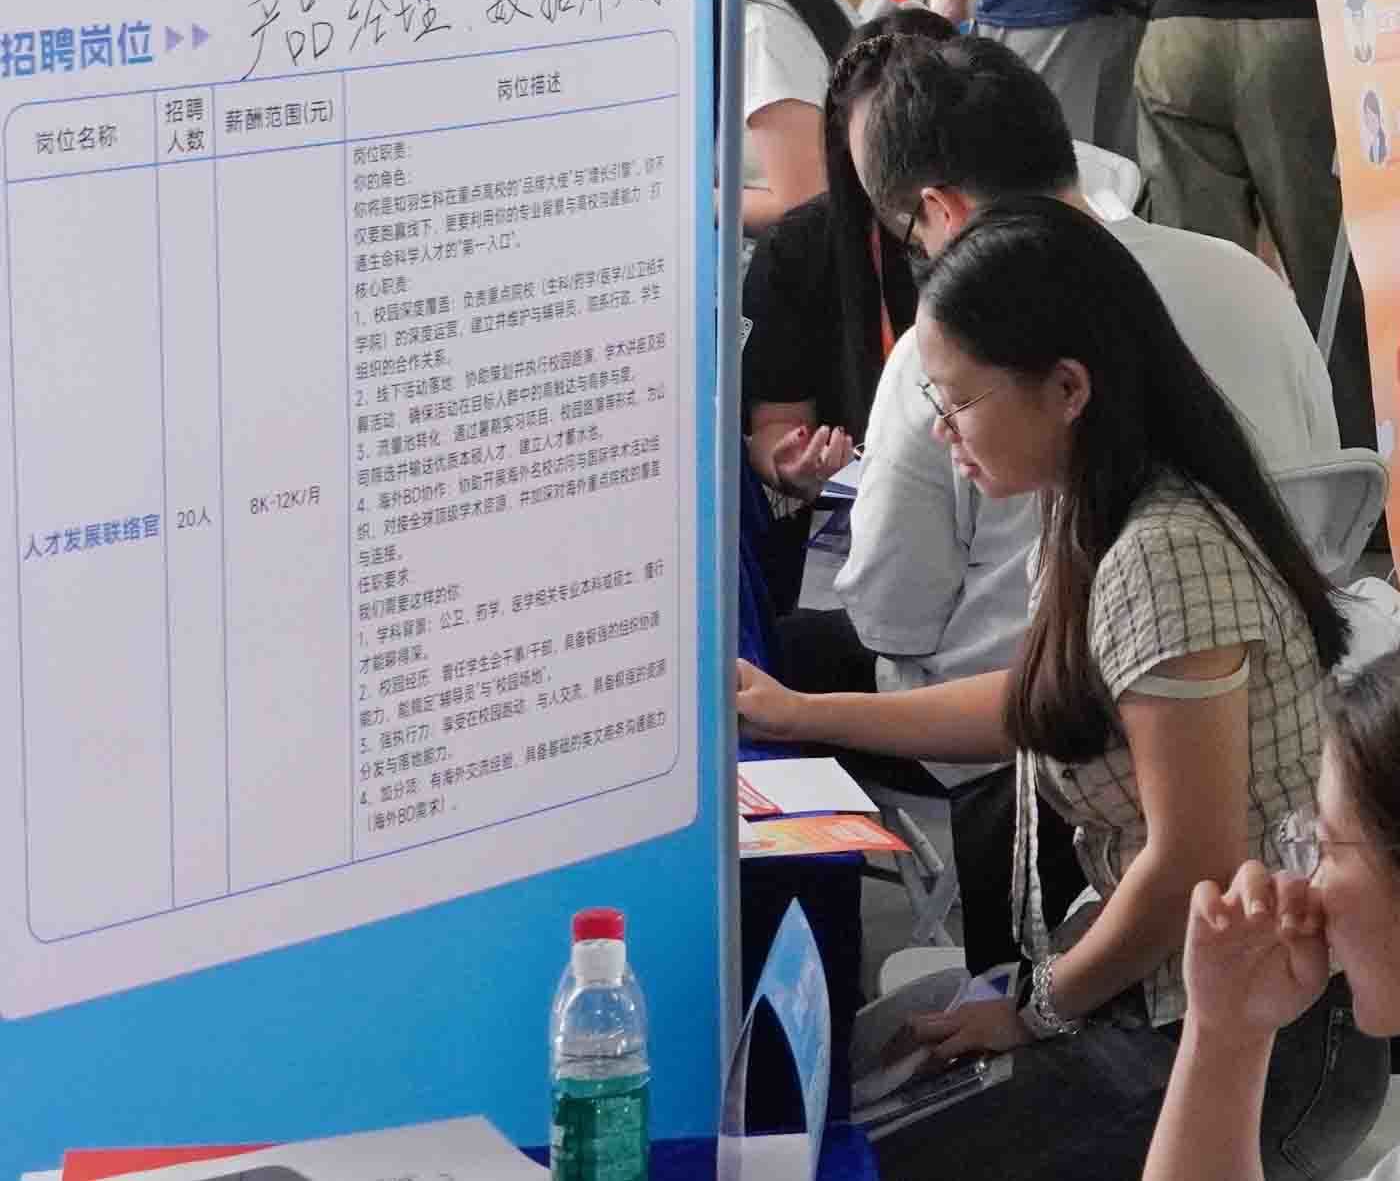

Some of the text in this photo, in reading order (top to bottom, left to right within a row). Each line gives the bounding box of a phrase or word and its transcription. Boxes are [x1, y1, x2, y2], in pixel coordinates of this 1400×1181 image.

[0, 20, 153, 77] 招聘岗位
[497, 70, 562, 101] 岗位描述
[166, 98, 204, 124] 招聘
[35, 123, 118, 156] 岗位名称
[167, 127, 206, 155] 人数
[176, 506, 211, 529] 20人
